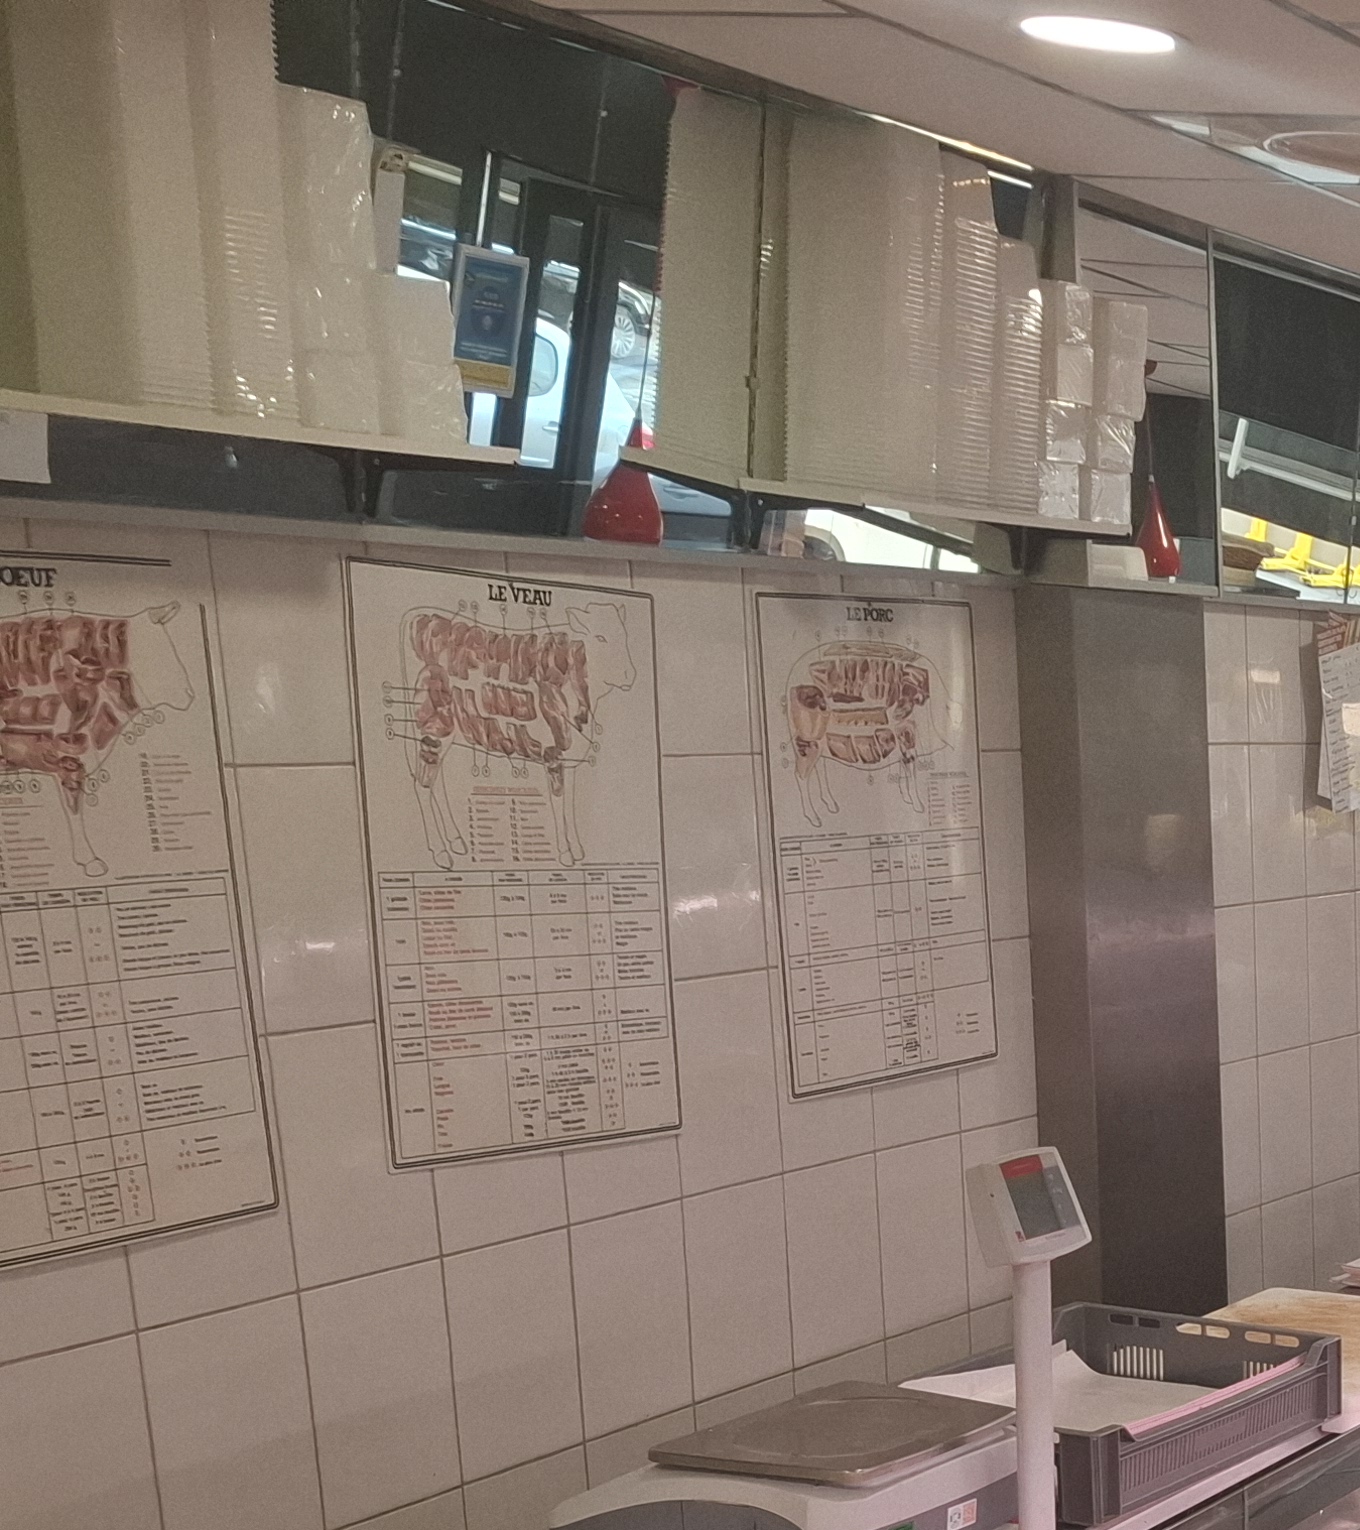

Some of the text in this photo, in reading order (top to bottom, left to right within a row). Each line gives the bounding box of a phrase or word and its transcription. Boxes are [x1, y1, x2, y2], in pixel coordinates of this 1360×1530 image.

[487, 584, 553, 607] LE VEAU
[846, 606, 894, 622] LE PORC
